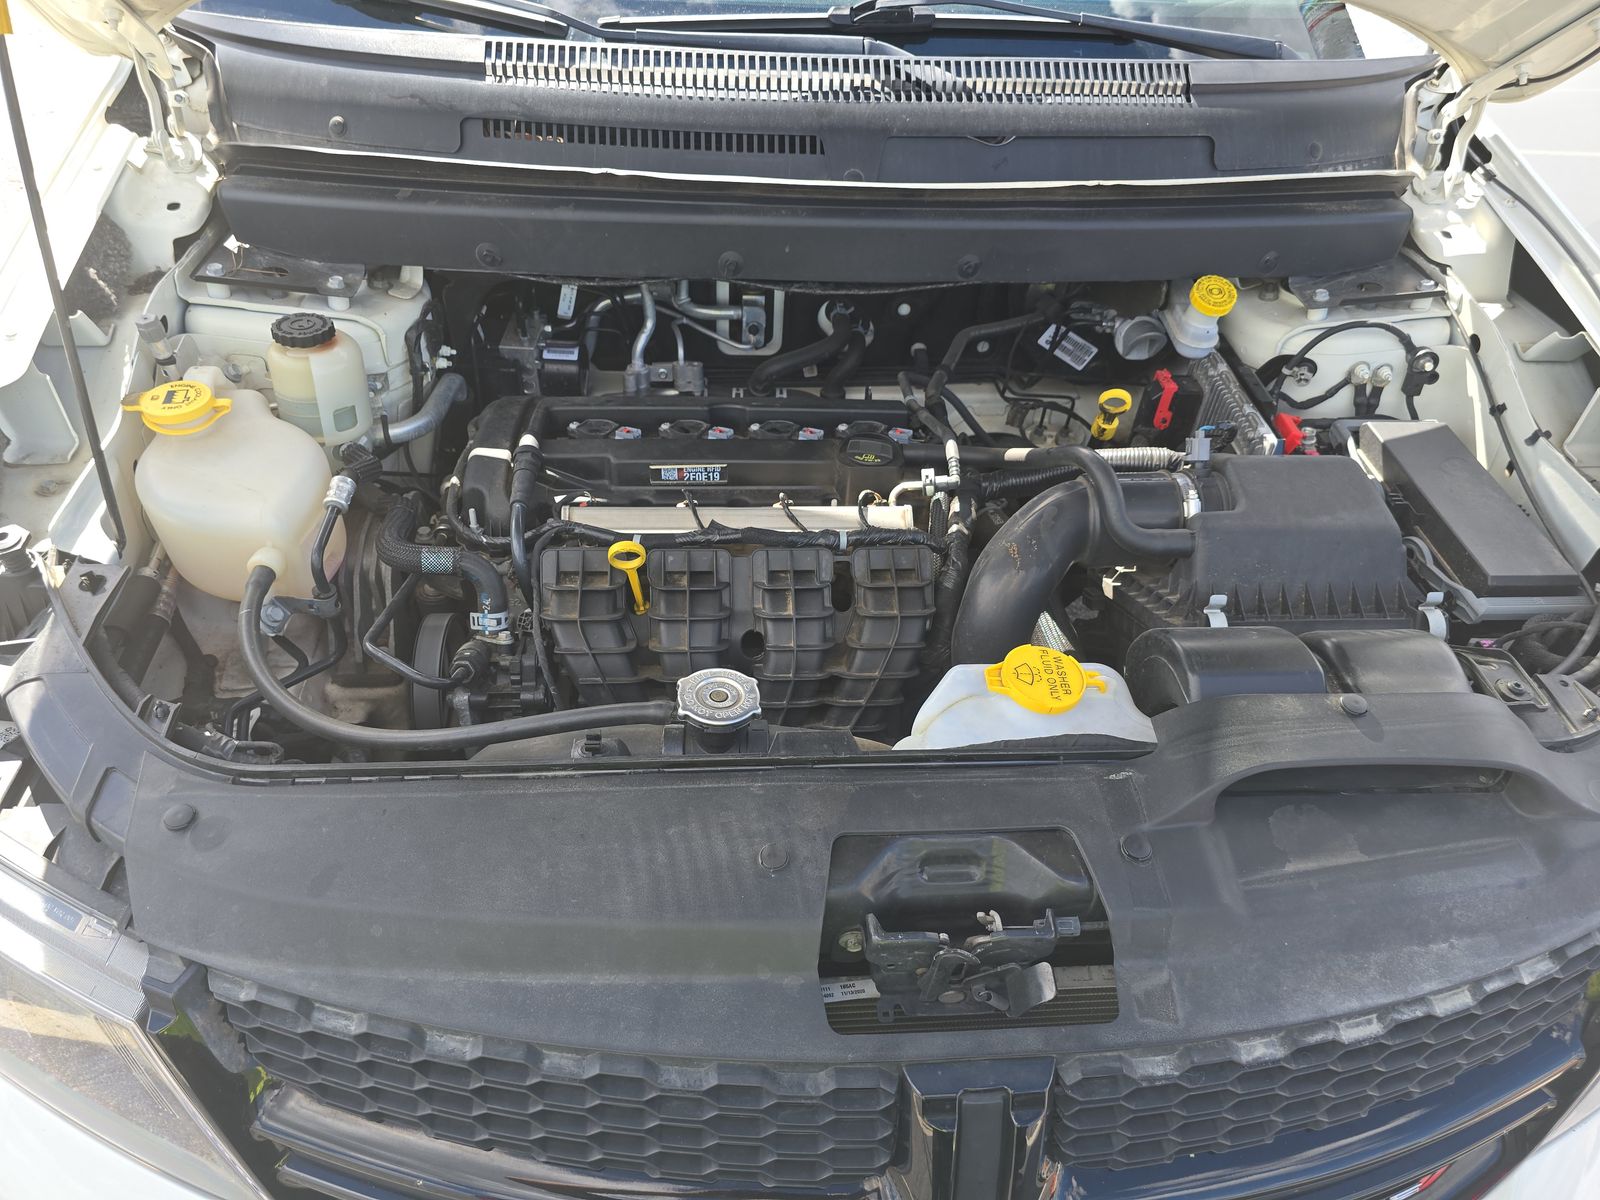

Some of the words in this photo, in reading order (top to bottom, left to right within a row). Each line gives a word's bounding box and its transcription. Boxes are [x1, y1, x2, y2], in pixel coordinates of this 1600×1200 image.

[1039, 649, 1054, 675] FLUID
[1052, 655, 1072, 696] WASHER
[1046, 678, 1062, 701] ONLY
[715, 707, 744, 719] OPEN
